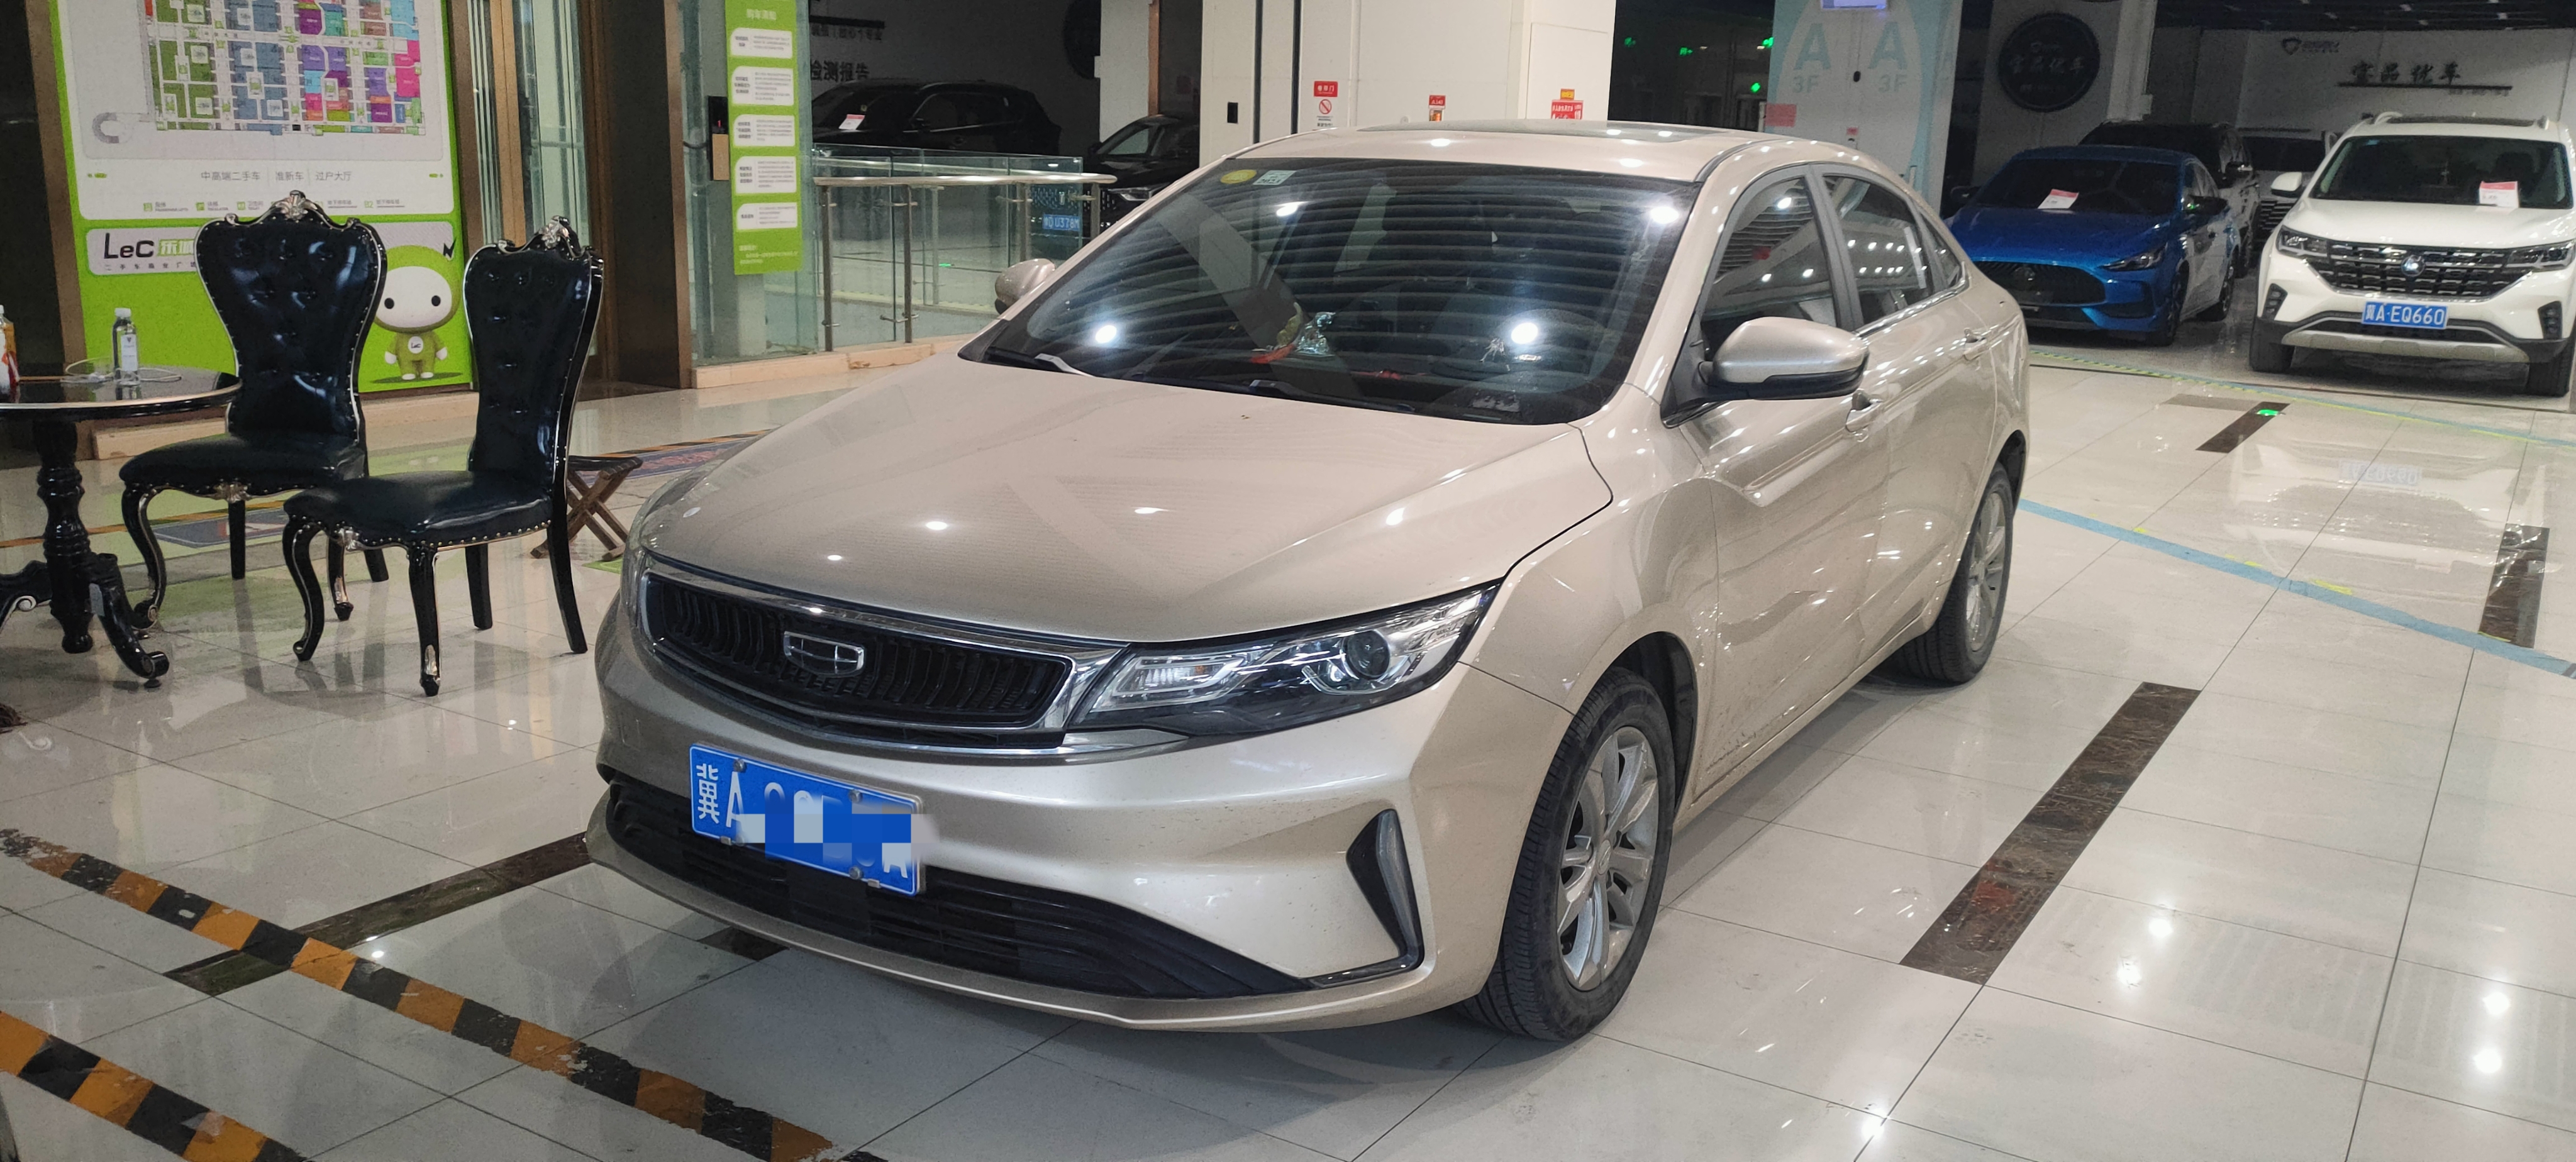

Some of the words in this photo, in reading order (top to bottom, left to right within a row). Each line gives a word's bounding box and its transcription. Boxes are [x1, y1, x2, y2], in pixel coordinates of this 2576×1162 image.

[1794, 23, 1831, 70] A
[1867, 22, 1907, 70] A
[1793, 75, 1819, 93] 3F
[1879, 74, 1907, 93] 3F
[201, 170, 261, 182] 中高端二手车
[275, 170, 304, 182] 准新车
[315, 170, 353, 182] 过户大厅
[104, 233, 155, 258] LeC
[1436, 626, 1451, 636] GEELY
